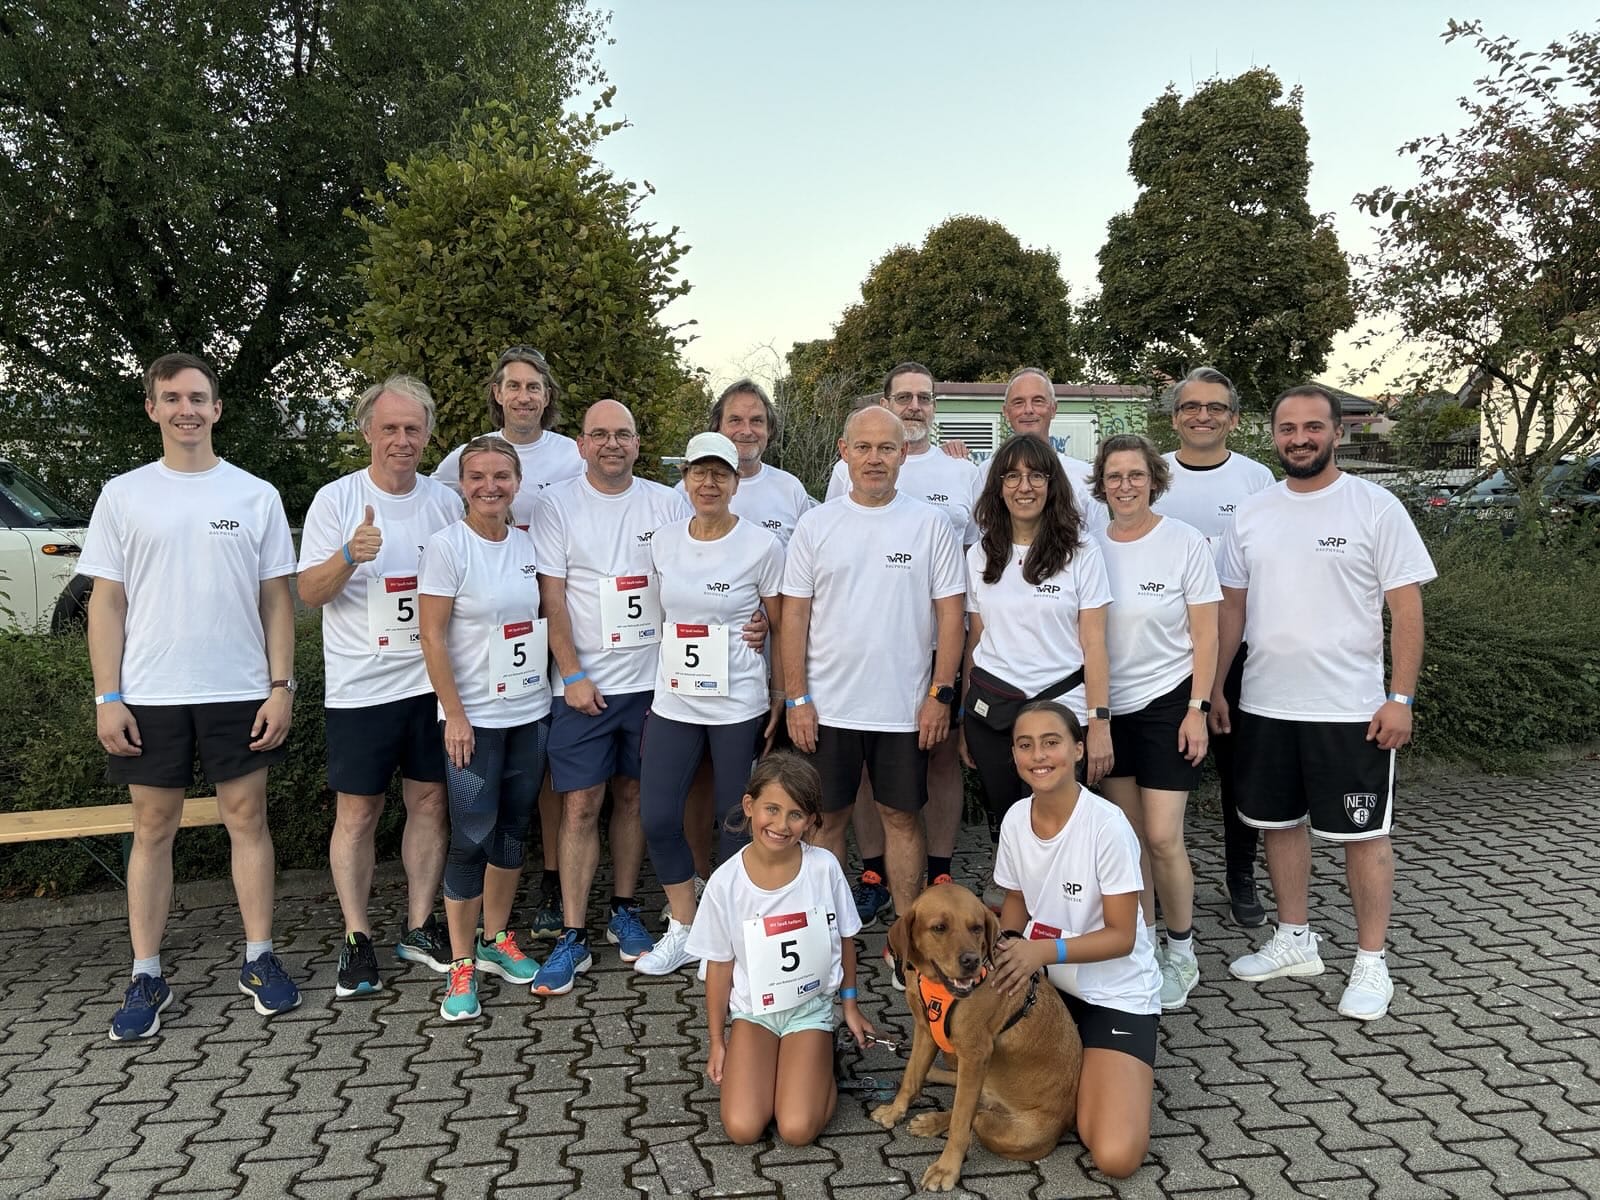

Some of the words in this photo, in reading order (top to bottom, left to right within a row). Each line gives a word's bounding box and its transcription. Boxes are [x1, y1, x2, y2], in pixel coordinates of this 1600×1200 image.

[397, 597, 414, 622] 5
[628, 595, 642, 619] 5
[513, 642, 526, 667] 5
[685, 644, 699, 668] 5
[1347, 795, 1376, 808] NETS
[1360, 810, 1365, 822] B
[781, 940, 800, 972] 5
